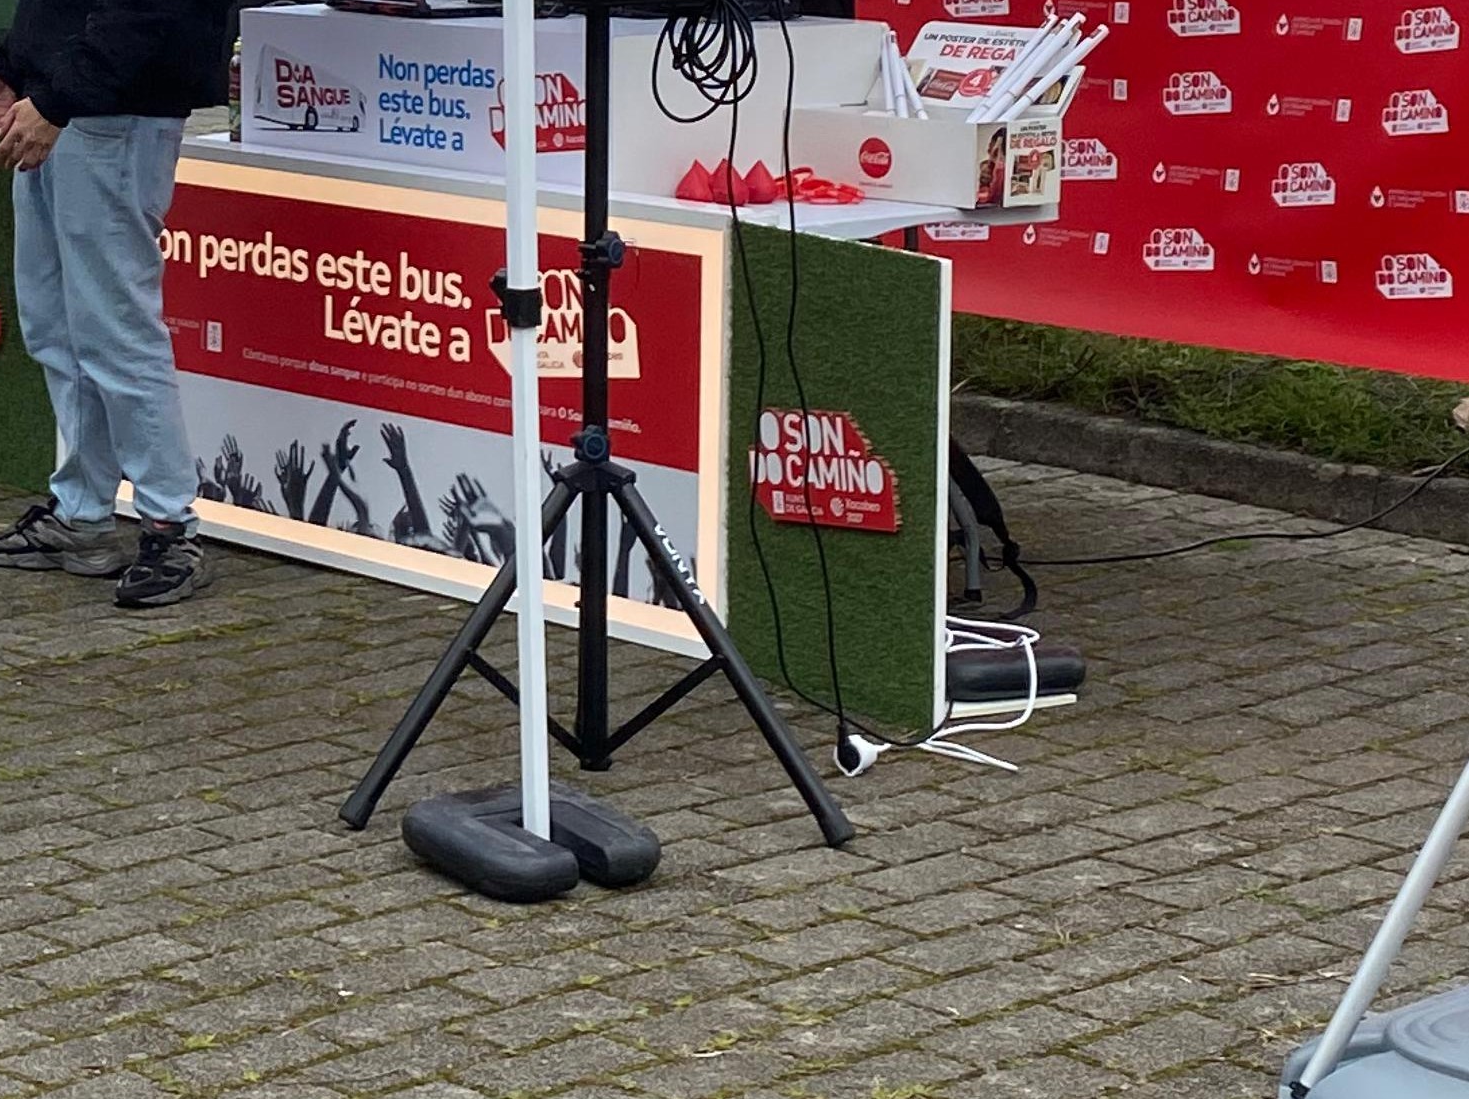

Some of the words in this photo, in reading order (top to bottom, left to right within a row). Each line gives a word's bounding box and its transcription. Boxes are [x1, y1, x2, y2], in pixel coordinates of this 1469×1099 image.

[940, 45, 966, 58] DE
[967, 47, 1017, 61] REGA
[379, 54, 420, 81] Non
[424, 60, 496, 90] perdas
[969, 75, 983, 87] 4
[277, 85, 351, 108] SANGUE
[379, 90, 423, 113] este
[429, 91, 471, 119] bus.
[379, 118, 446, 149] Lévate
[451, 131, 464, 151] a
[157, 229, 191, 261] on
[200, 232, 309, 282] perdas
[316, 250, 392, 296] este
[400, 252, 472, 310] bus.
[325, 295, 441, 359] Lévate
[448, 327, 471, 363] a
[760, 411, 780, 450] O
[783, 413, 845, 456] SON
[786, 450, 884, 494] CAMIÑO
